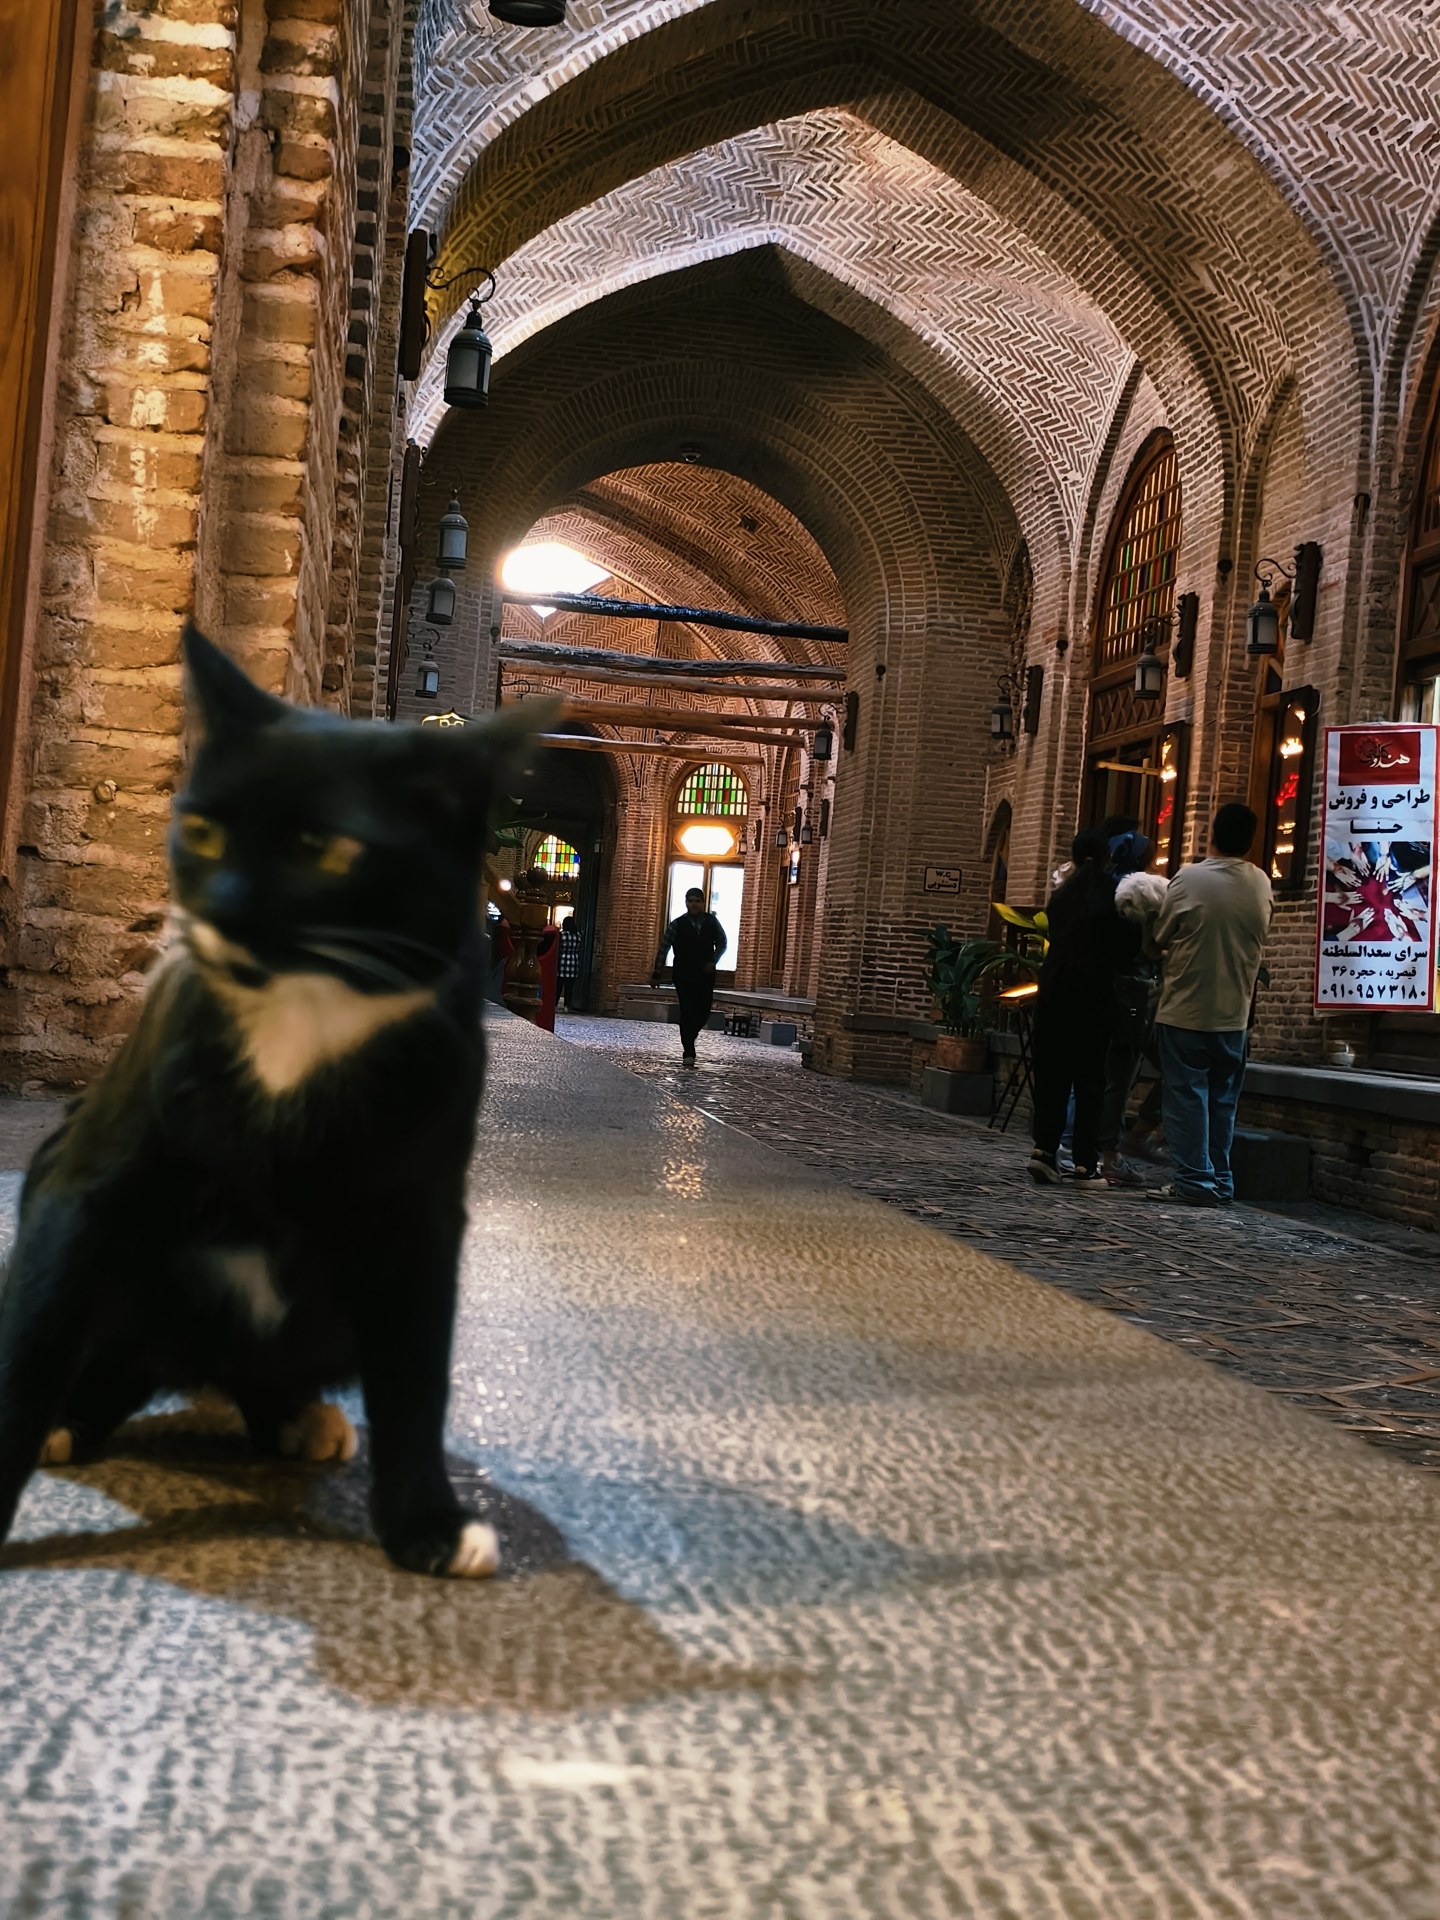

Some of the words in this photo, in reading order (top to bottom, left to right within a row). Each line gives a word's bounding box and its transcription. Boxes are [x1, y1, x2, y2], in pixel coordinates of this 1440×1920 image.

[1328, 788, 1367, 810] فروش
[1370, 796, 1378, 809] و
[1381, 788, 1430, 809] طراحی
[1350, 819, 1403, 834] حنا
[935, 870, 952, 878] W.C
[1322, 944, 1392, 958] سعدالسلطنه
[1394, 945, 1428, 962] سرای
[1331, 965, 1348, 977] ۳۶
[1349, 968, 1376, 980] حجره
[1385, 966, 1417, 980] قیصریه
[1322, 983, 1426, 999] ۰۹۱۰۹۵۷۳۱۸۰
